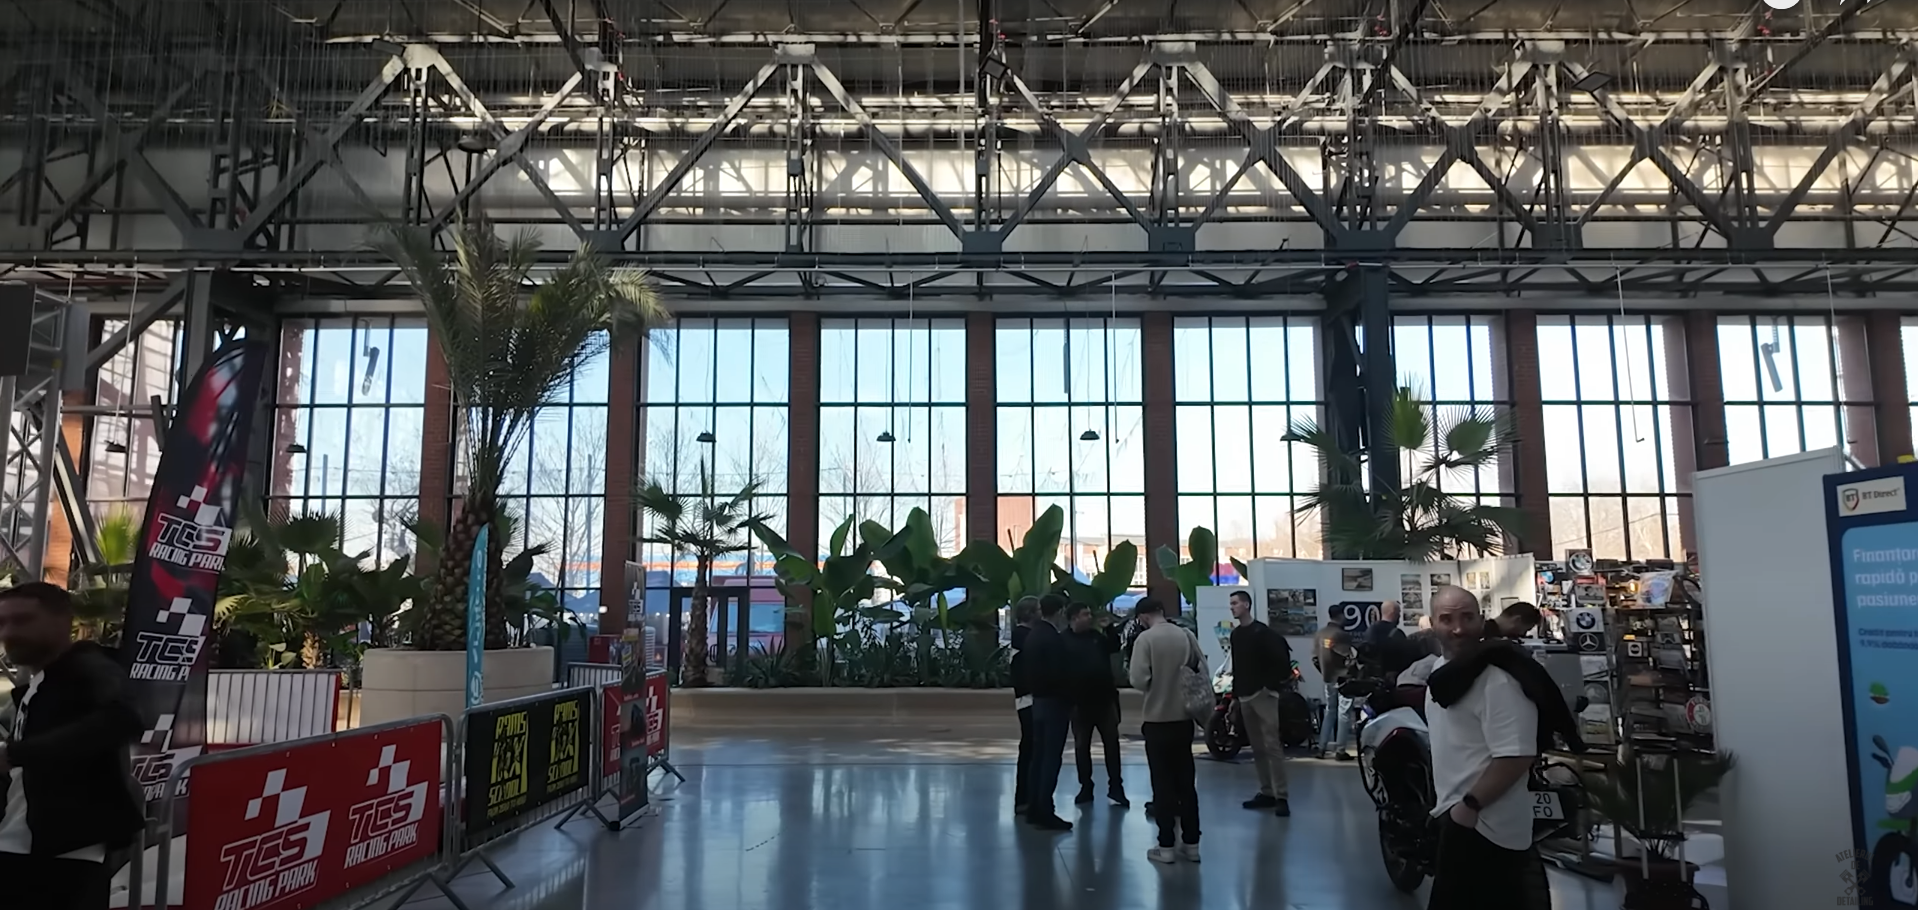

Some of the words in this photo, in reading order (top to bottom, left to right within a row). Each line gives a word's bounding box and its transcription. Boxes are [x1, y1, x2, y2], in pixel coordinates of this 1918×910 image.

[1862, 491, 1872, 500] BT
[157, 512, 230, 554] TCS
[149, 542, 190, 566] RACING
[1857, 591, 1918, 609] pasiune
[1343, 604, 1380, 631] 90
[129, 662, 179, 681] RACING
[349, 781, 428, 844] TCS
[1535, 793, 1551, 805] 20
[220, 811, 328, 891] TCS
[344, 838, 388, 870] RACING
[386, 822, 418, 853] PARK
[213, 874, 276, 910] RACING
[275, 859, 319, 897] PARK
